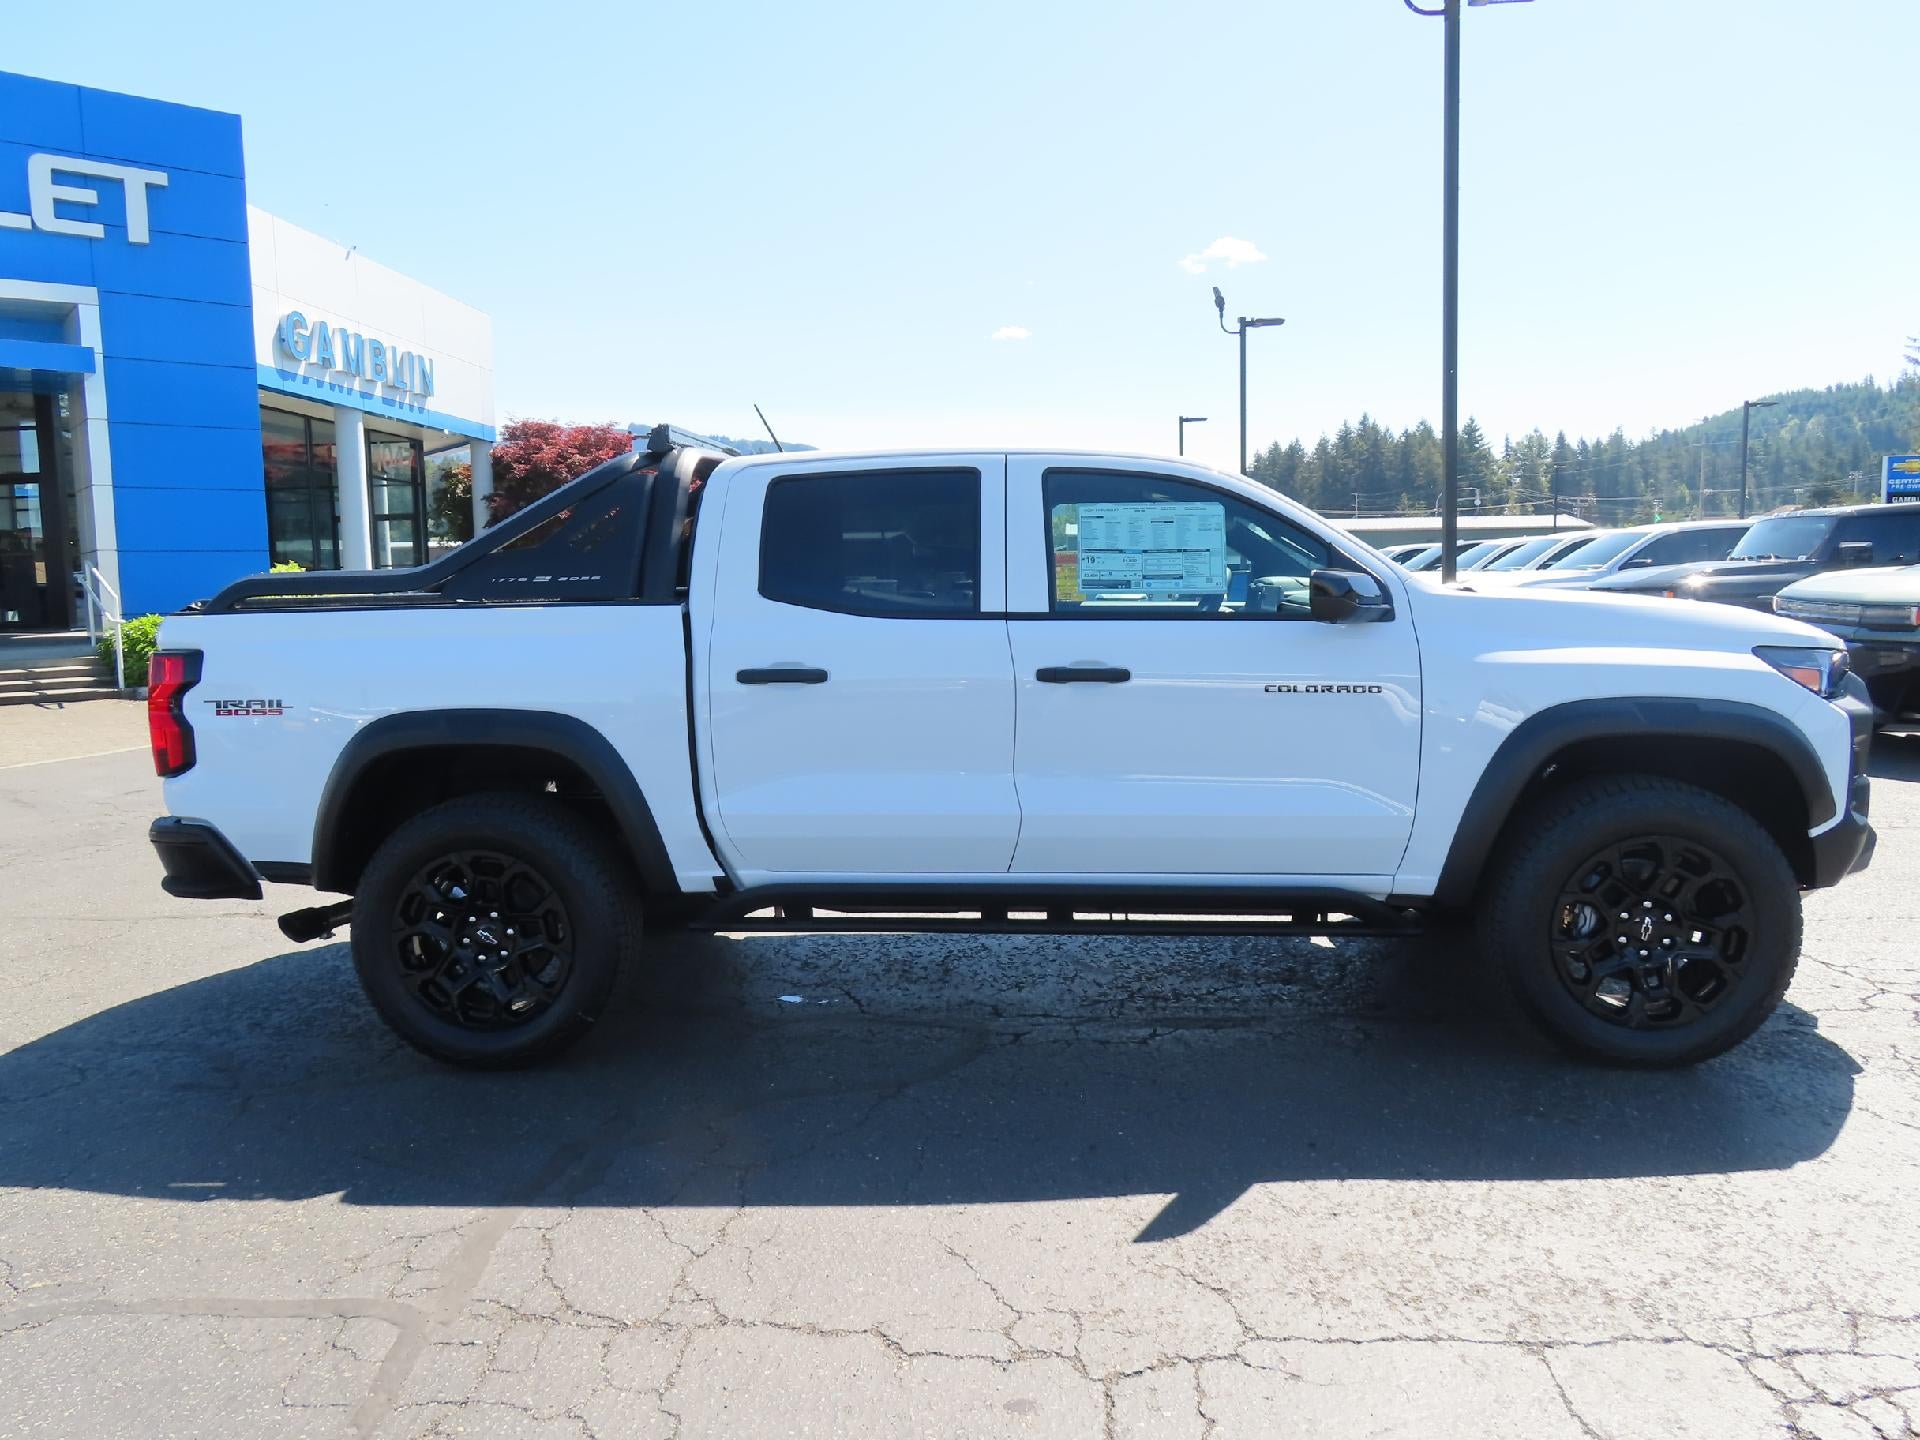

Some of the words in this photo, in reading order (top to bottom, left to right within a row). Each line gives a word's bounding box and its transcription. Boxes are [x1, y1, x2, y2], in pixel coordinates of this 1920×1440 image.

[279, 310, 434, 397] GAMBLIN
[1264, 685, 1382, 693] COLORADO
[203, 700, 294, 708] TRAIL
[216, 708, 283, 716] BOSS
